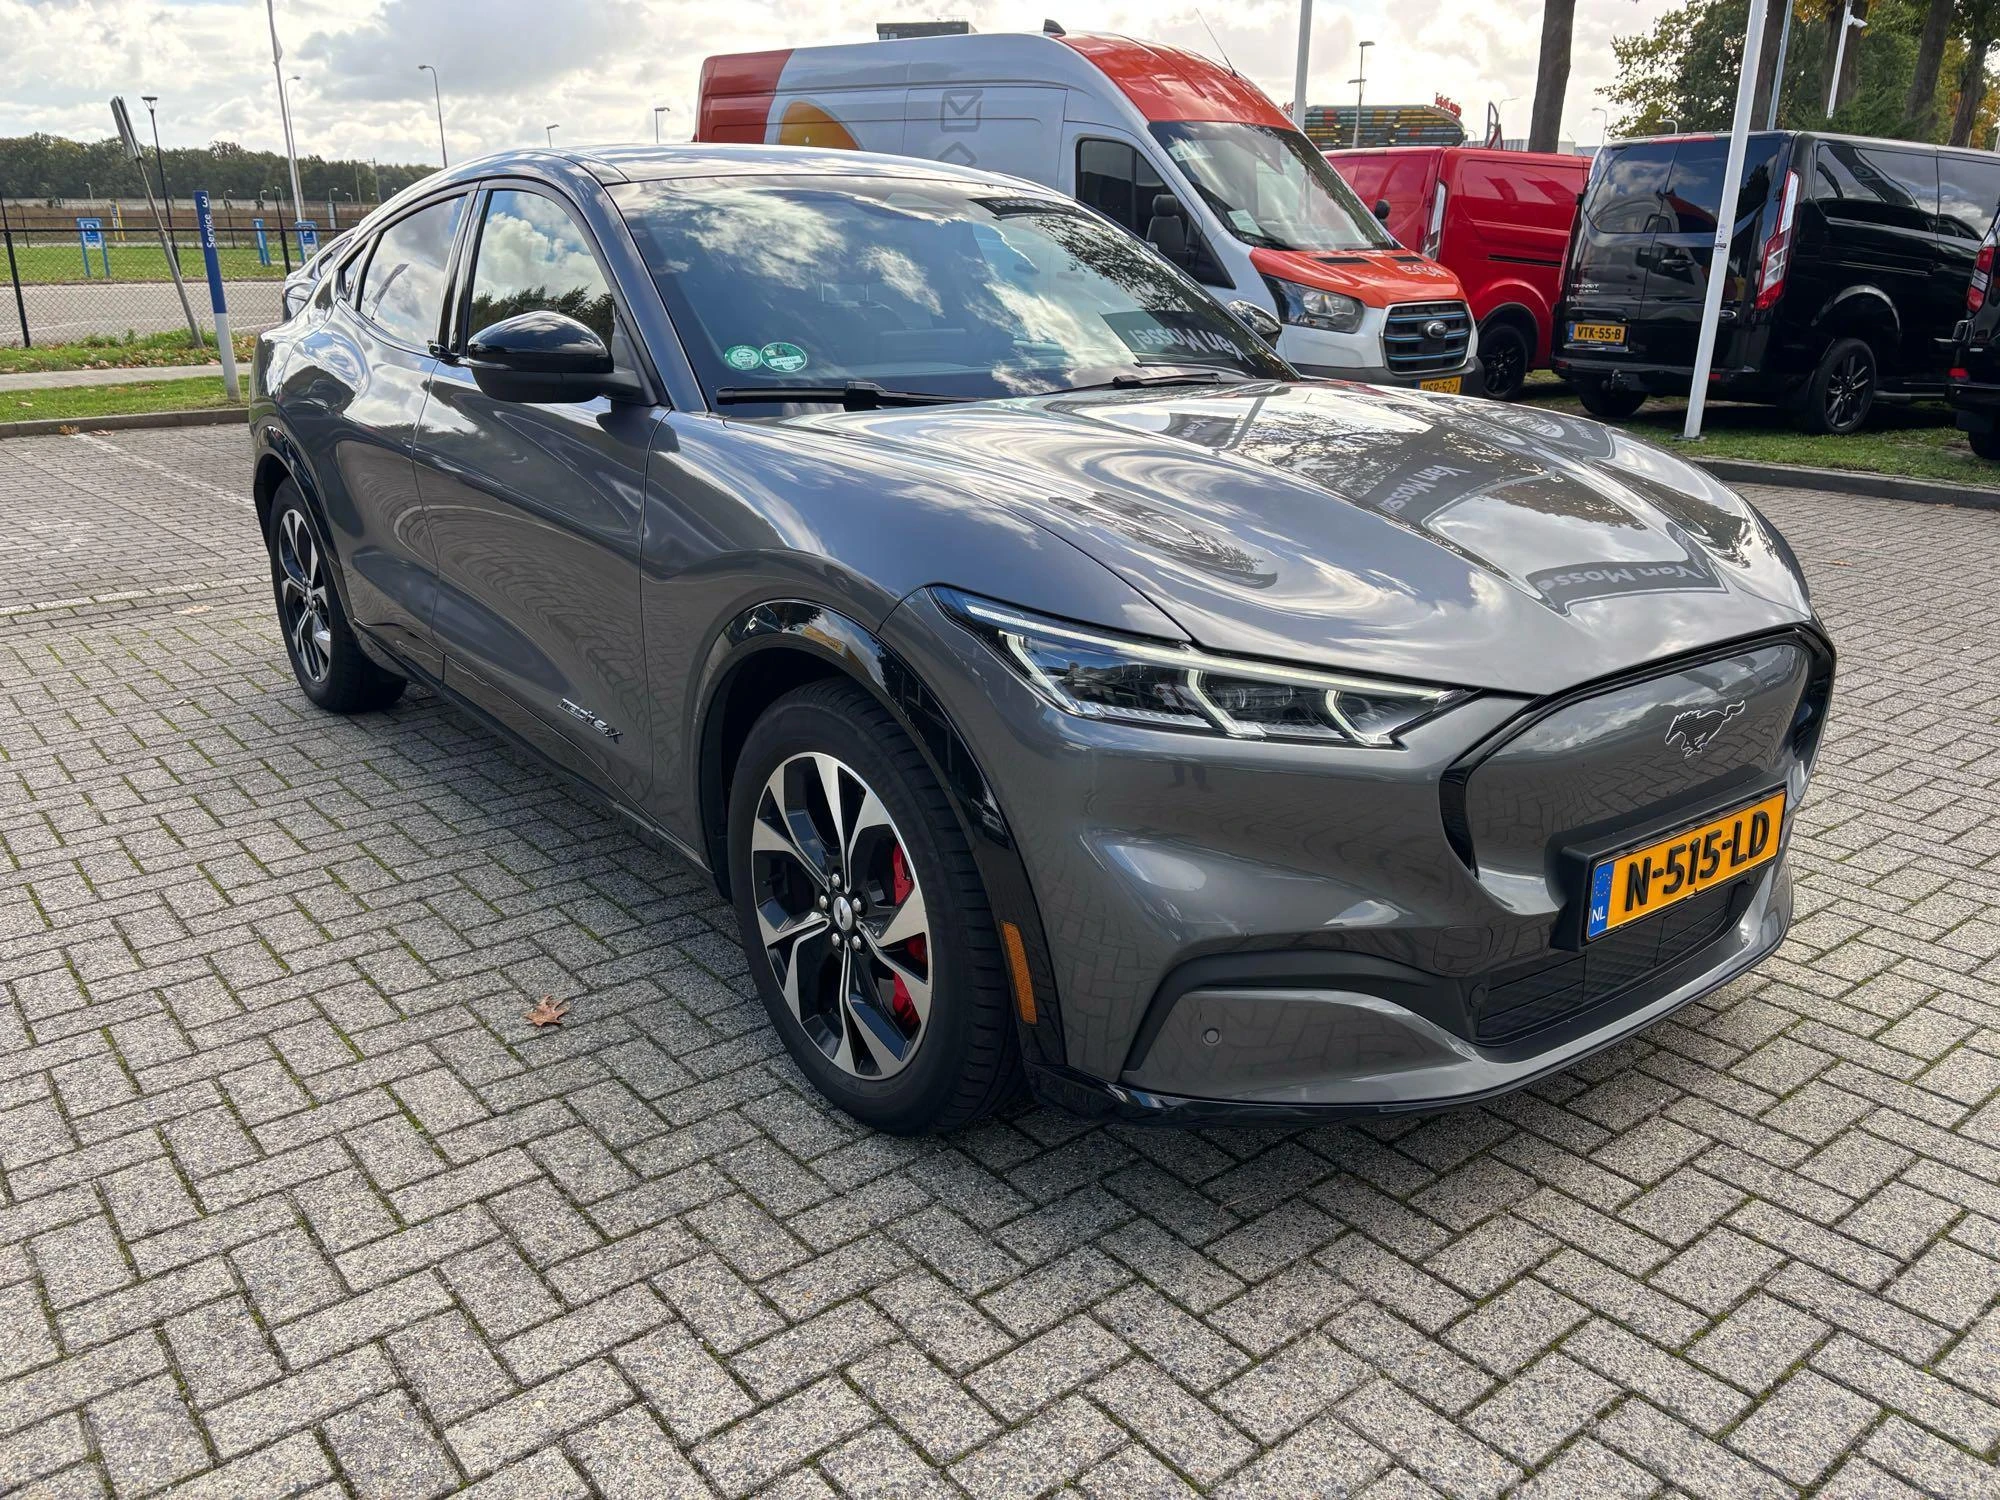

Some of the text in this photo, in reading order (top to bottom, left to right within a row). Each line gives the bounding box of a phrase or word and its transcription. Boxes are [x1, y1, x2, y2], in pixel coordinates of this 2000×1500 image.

[201, 196, 216, 248] Service 3
[1577, 326, 1622, 340] VTK-55-B
[1624, 810, 1770, 912] N-515-LD
[1591, 905, 1606, 924] NL
